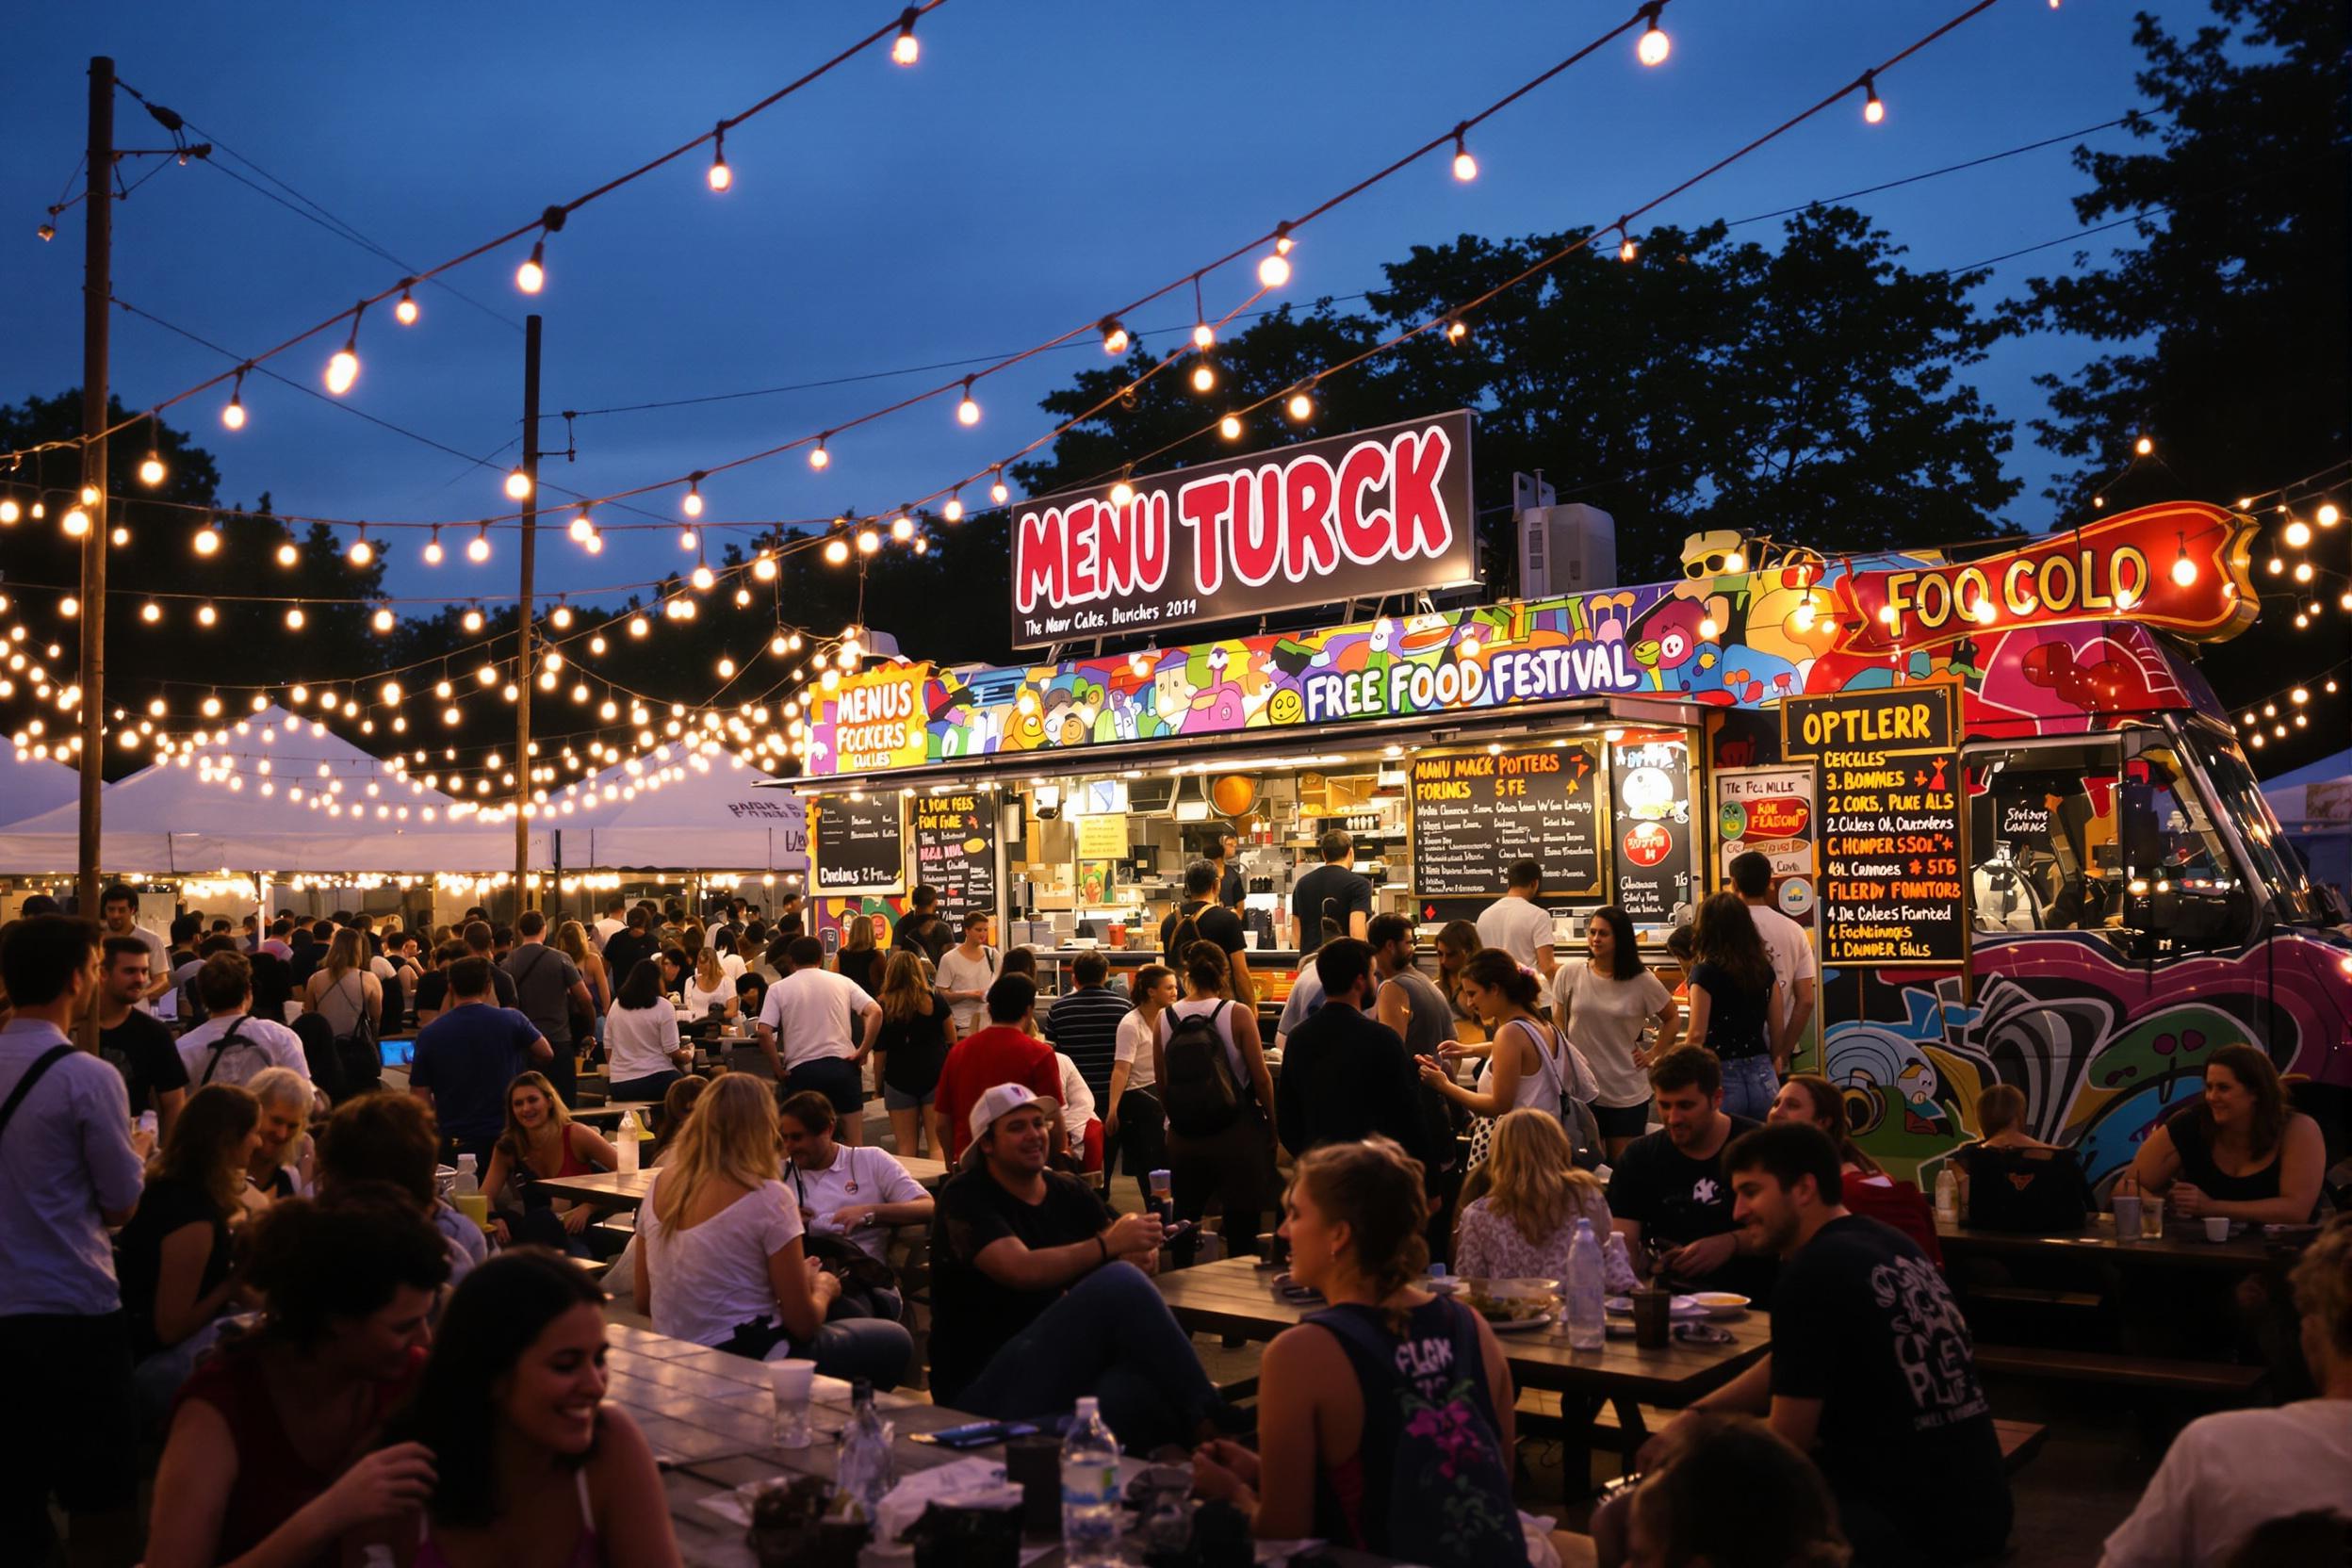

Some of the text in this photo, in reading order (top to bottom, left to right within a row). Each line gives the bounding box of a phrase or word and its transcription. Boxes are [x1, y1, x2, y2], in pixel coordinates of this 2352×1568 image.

[1017, 425, 1453, 614] MENU TURCK
[1025, 619, 1042, 637] The
[836, 681, 912, 724] MENUS
[1307, 645, 1637, 722] FREE FOOD FESTIVAL
[1803, 704, 1931, 745] OPTLERR
[1925, 792, 1954, 809] ALS
